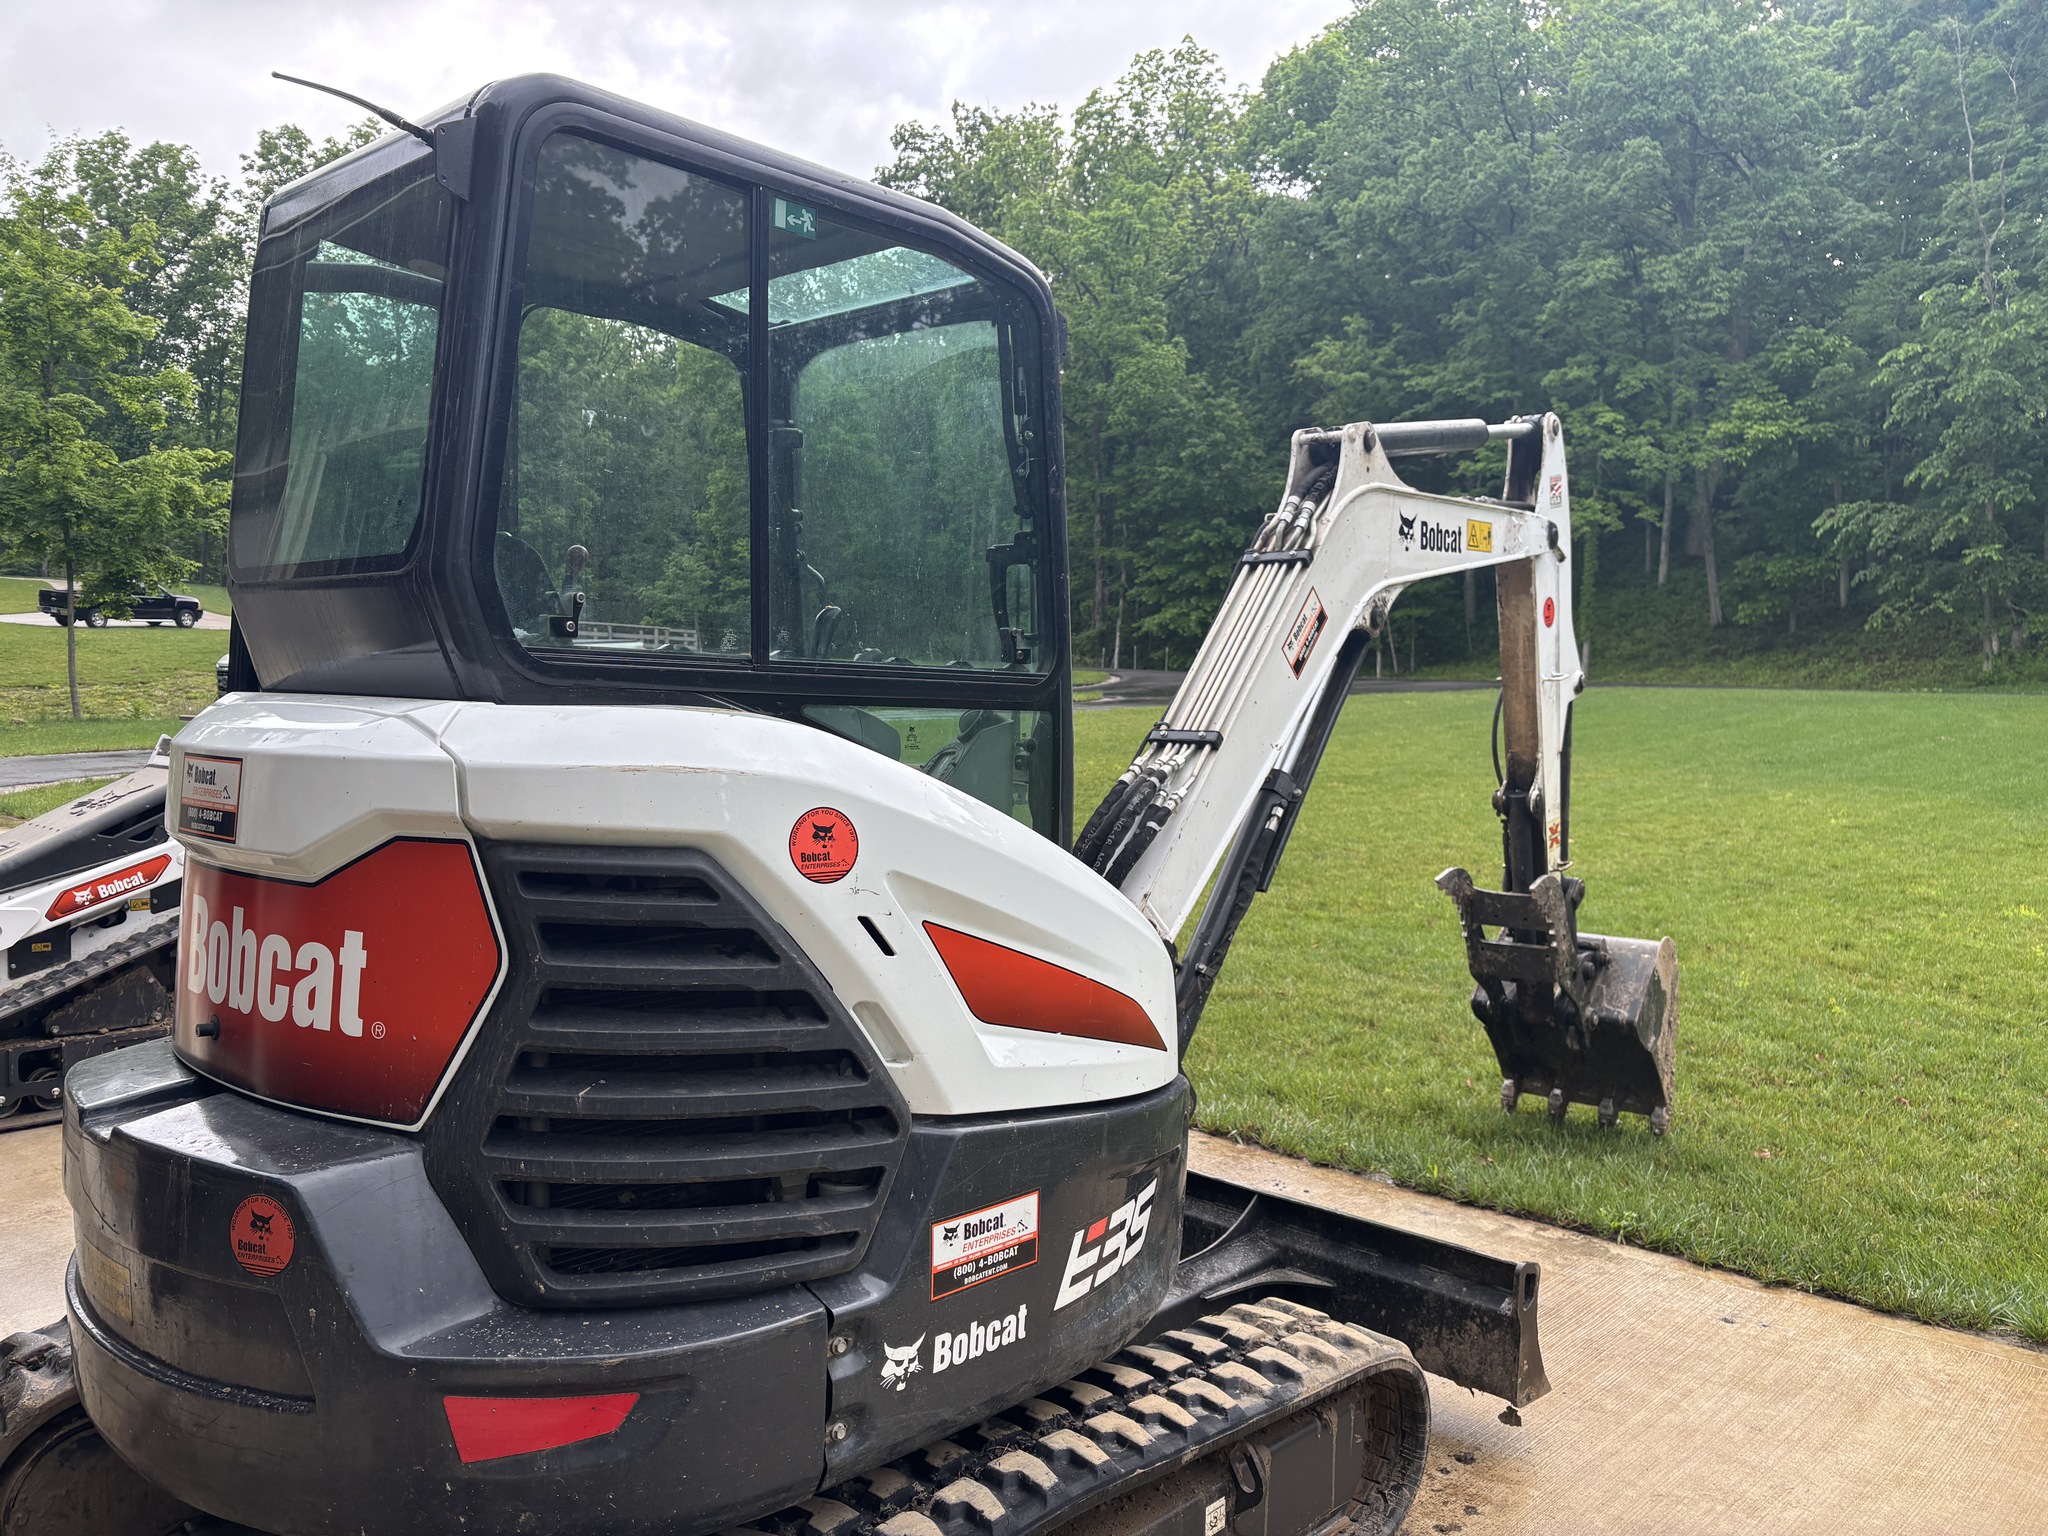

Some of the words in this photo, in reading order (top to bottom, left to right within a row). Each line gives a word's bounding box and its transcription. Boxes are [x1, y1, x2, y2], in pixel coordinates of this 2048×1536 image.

[1421, 521, 1462, 554] Bobcat
[1293, 614, 1307, 641] Bobcat
[194, 765, 216, 786] Bobcat
[192, 786, 223, 799] ENTERPRISES
[199, 808, 223, 822] 4-BOBCAT
[791, 817, 807, 847] WORKING
[807, 810, 820, 819] FOR
[834, 812, 850, 828] SINCE
[801, 851, 831, 863] Bobcat
[801, 861, 841, 870] ENTERPRISES
[97, 871, 146, 899] Bobcat
[188, 893, 368, 1038] Bobcat
[231, 1202, 247, 1231] WORKING
[247, 1197, 260, 1205] FOR
[260, 1197, 273, 1206] YOU
[274, 1204, 289, 1223] SINCE
[964, 1212, 1004, 1241] Bobcat
[238, 1239, 266, 1254] Bobcat
[962, 1226, 1017, 1253] ENTERPRISES
[1053, 1177, 1158, 1311] E35
[237, 1251, 276, 1264] ENTERPRISES
[953, 1261, 976, 1279] (800)
[978, 1245, 1019, 1268] 4-BOBCAT
[964, 1263, 1008, 1285] BOBCATENT.COM
[932, 1303, 1028, 1374] Bobcat
